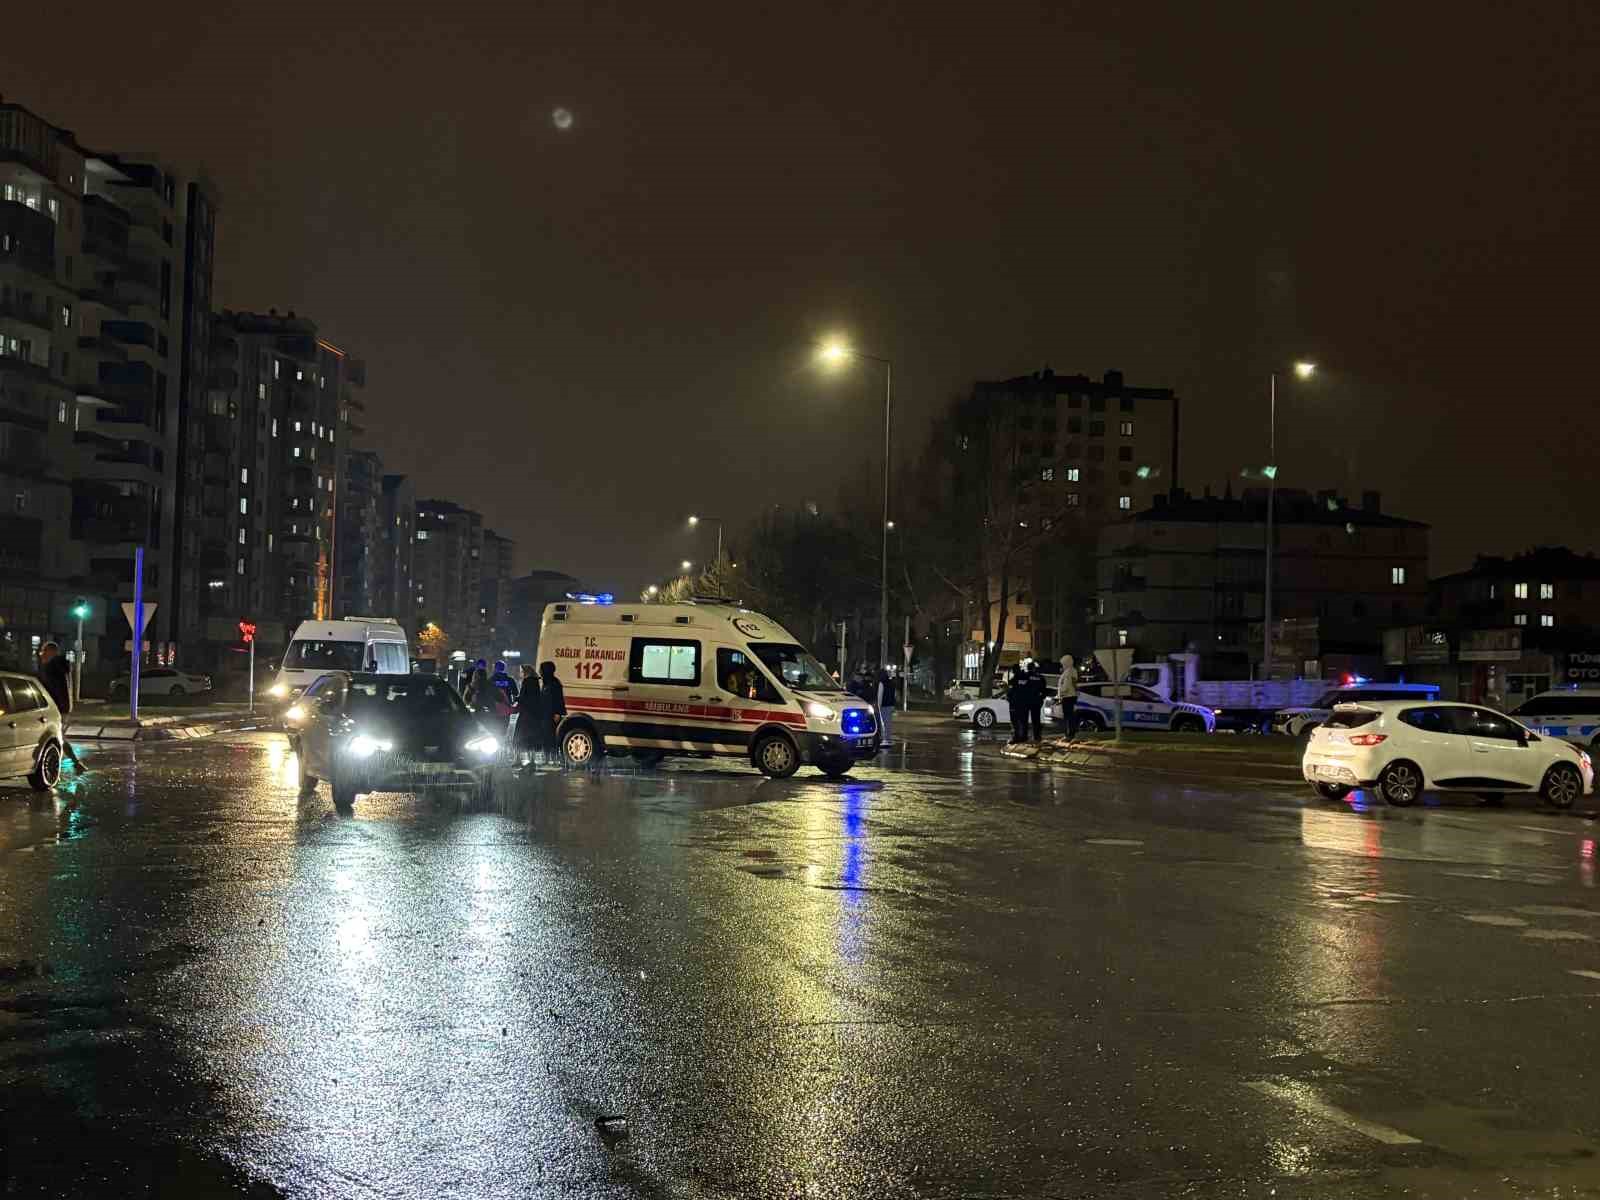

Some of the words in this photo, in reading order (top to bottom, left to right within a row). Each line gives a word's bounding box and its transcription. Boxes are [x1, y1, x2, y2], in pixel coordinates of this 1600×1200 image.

[555, 646, 580, 658] SAĞLIK
[585, 648, 626, 661] BAKANLIĞI
[575, 662, 603, 679] 112
